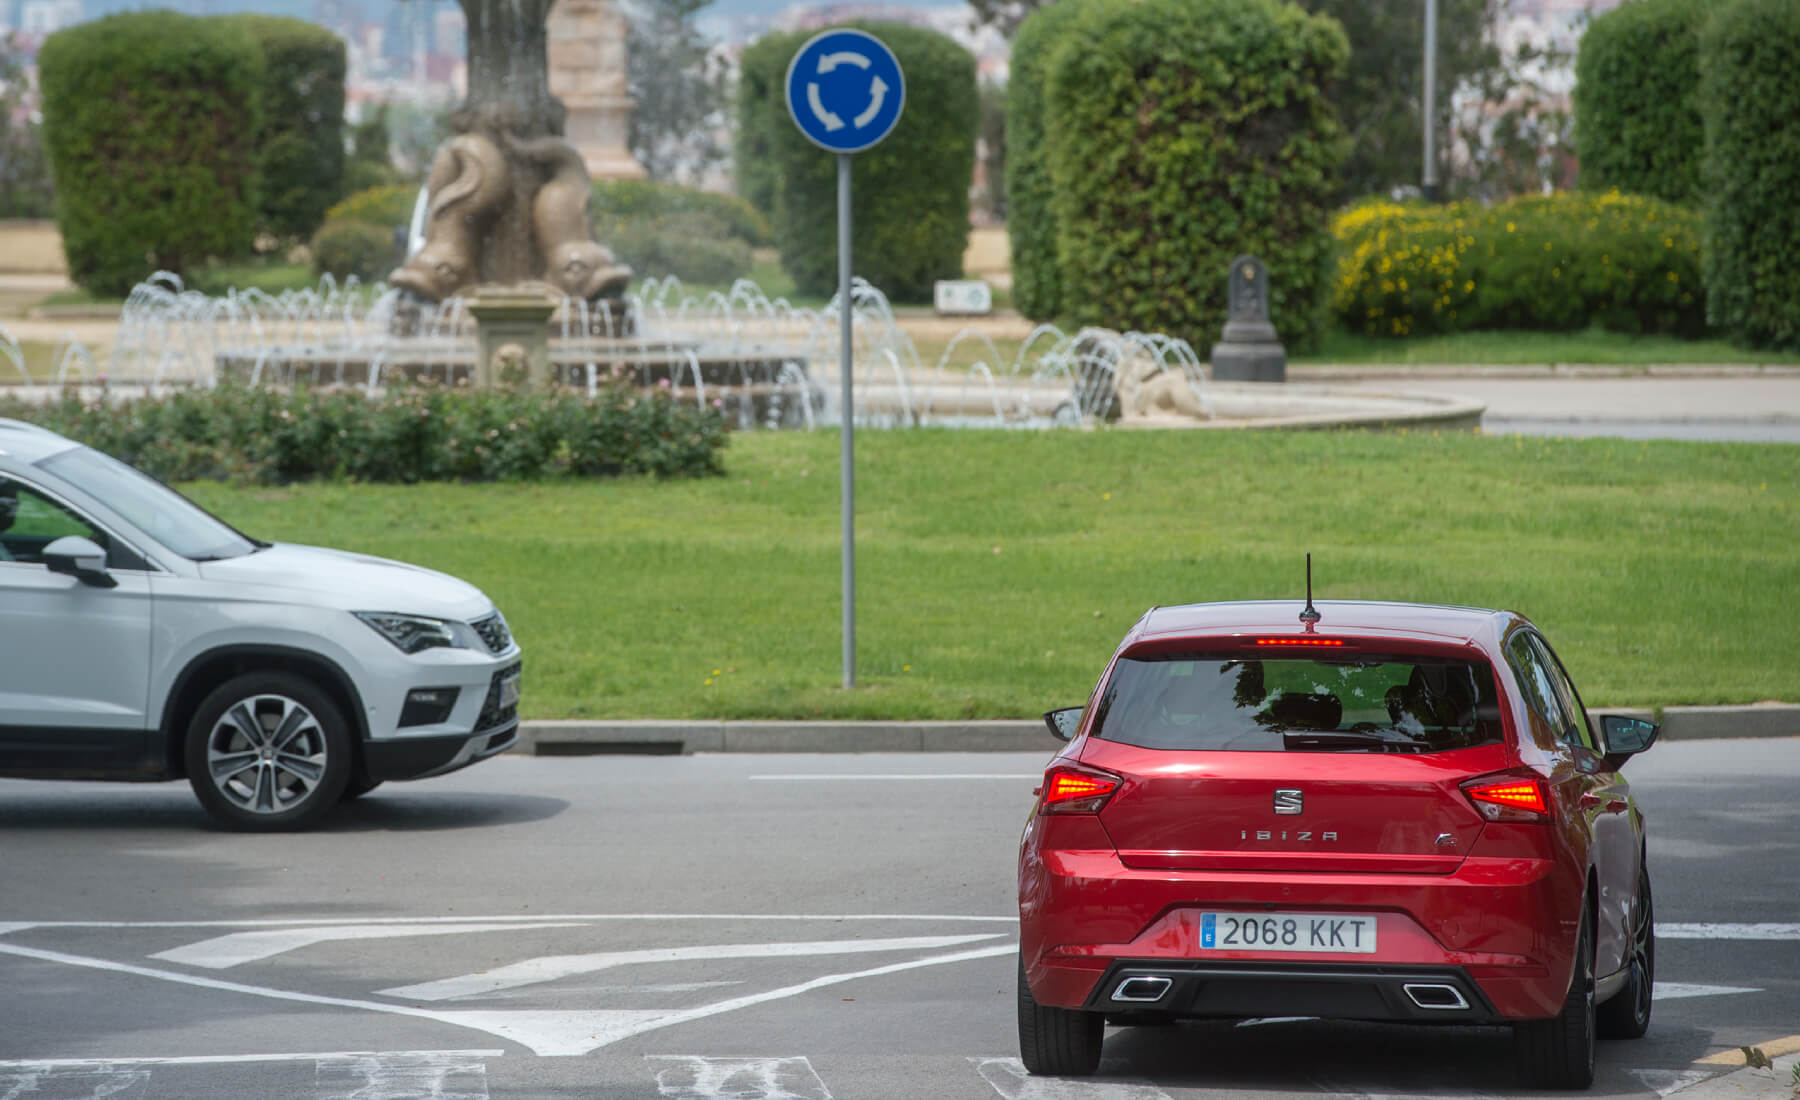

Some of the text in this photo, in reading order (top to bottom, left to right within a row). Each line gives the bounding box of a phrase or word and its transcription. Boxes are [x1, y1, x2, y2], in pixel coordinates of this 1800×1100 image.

[1205, 933, 1212, 942] E
[1223, 917, 1366, 948] 2068 KKT
